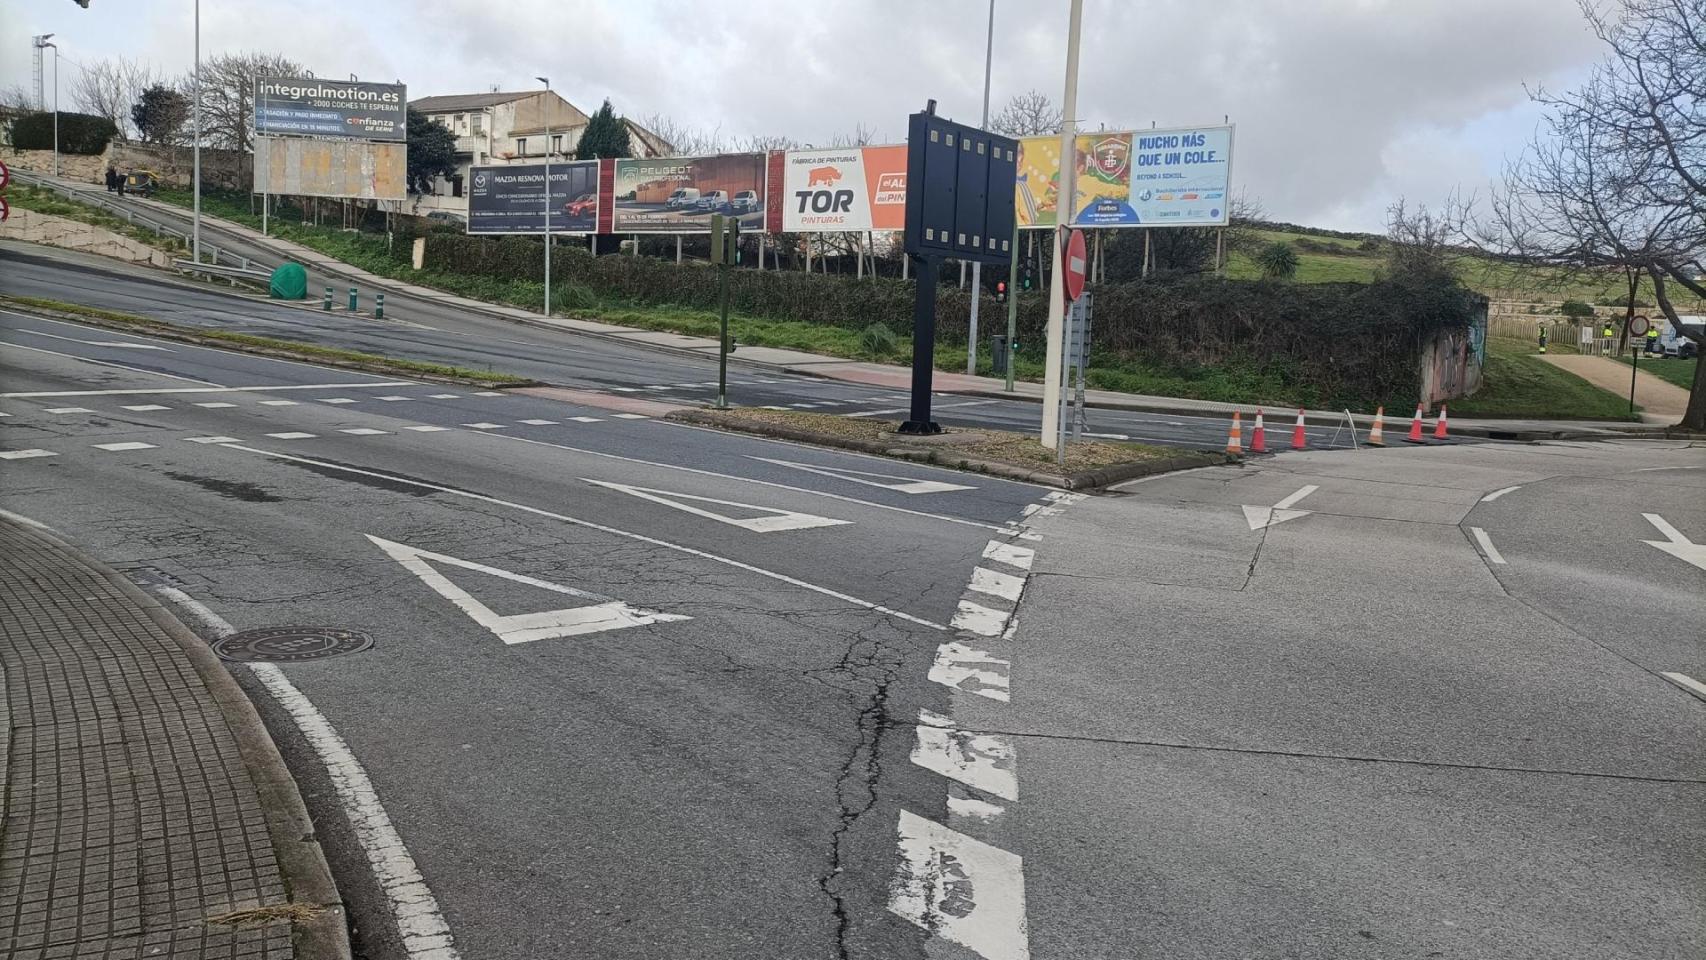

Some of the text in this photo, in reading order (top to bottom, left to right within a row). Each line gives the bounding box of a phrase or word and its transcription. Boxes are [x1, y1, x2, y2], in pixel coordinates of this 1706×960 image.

[260, 81, 399, 102] integralmotion.es
[314, 100, 398, 112] 2000 COCHES TE ESPERAN
[346, 117, 394, 126] confianza
[1139, 132, 1205, 149] MUCHO MÁS
[1138, 151, 1225, 166] QUE UN COLE...
[640, 166, 692, 174] PEUGEOT
[494, 175, 517, 183] MAZDA
[891, 179, 906, 188] AL
[795, 190, 854, 213] TOR
[887, 193, 905, 202] PIN
[801, 216, 845, 224] PINTURAS
